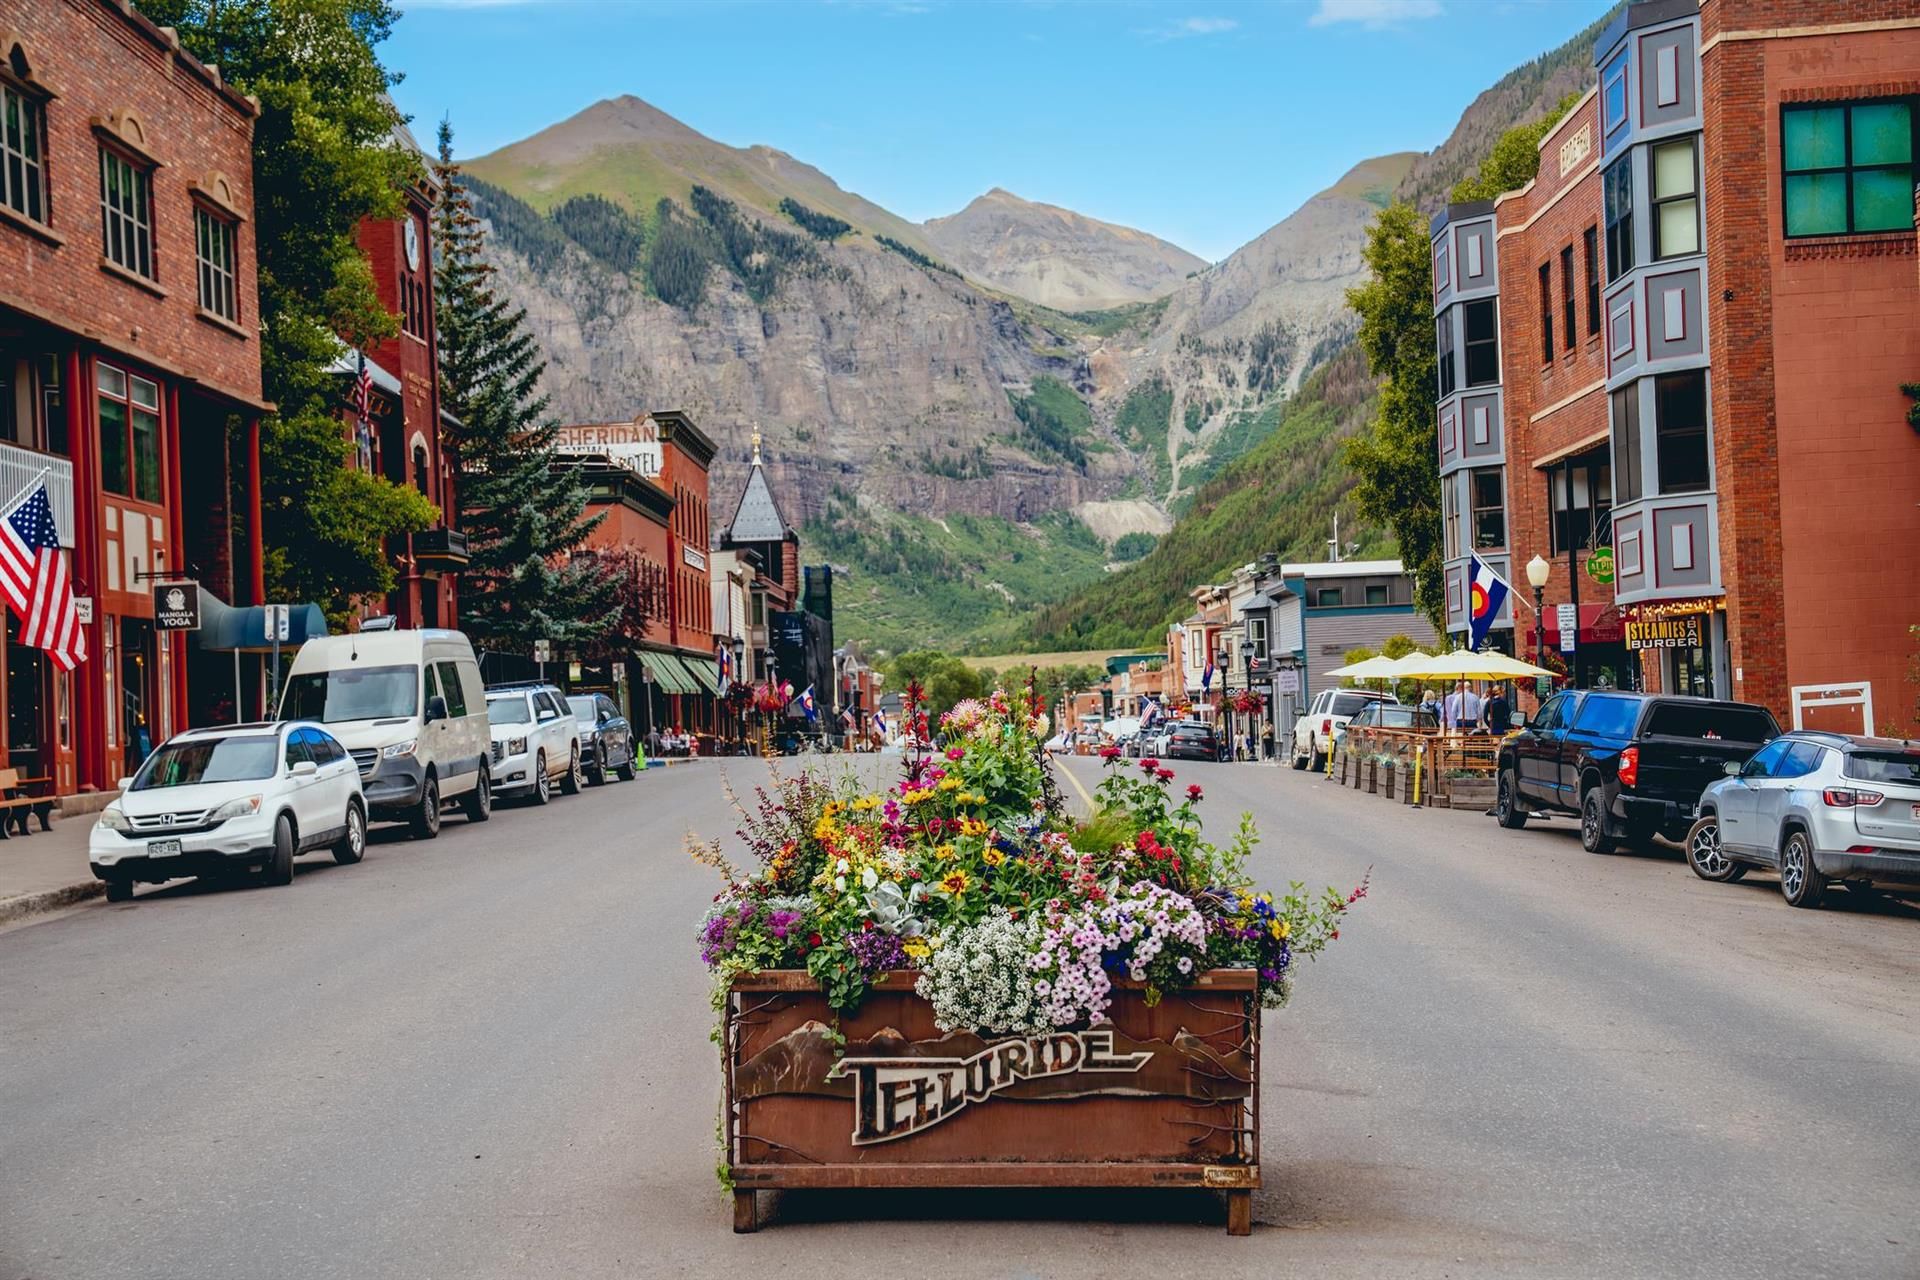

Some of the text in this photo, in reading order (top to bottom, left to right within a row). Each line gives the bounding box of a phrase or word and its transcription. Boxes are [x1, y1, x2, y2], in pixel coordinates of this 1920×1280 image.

[558, 425, 656, 446] SHERIDAN
[158, 611, 194, 619] MANGALA
[162, 618, 191, 627] YOGA
[1630, 621, 1686, 640] STEAMIES
[1631, 637, 1698, 649] BURGER
[830, 1031, 1152, 1144] TELLURIDE
